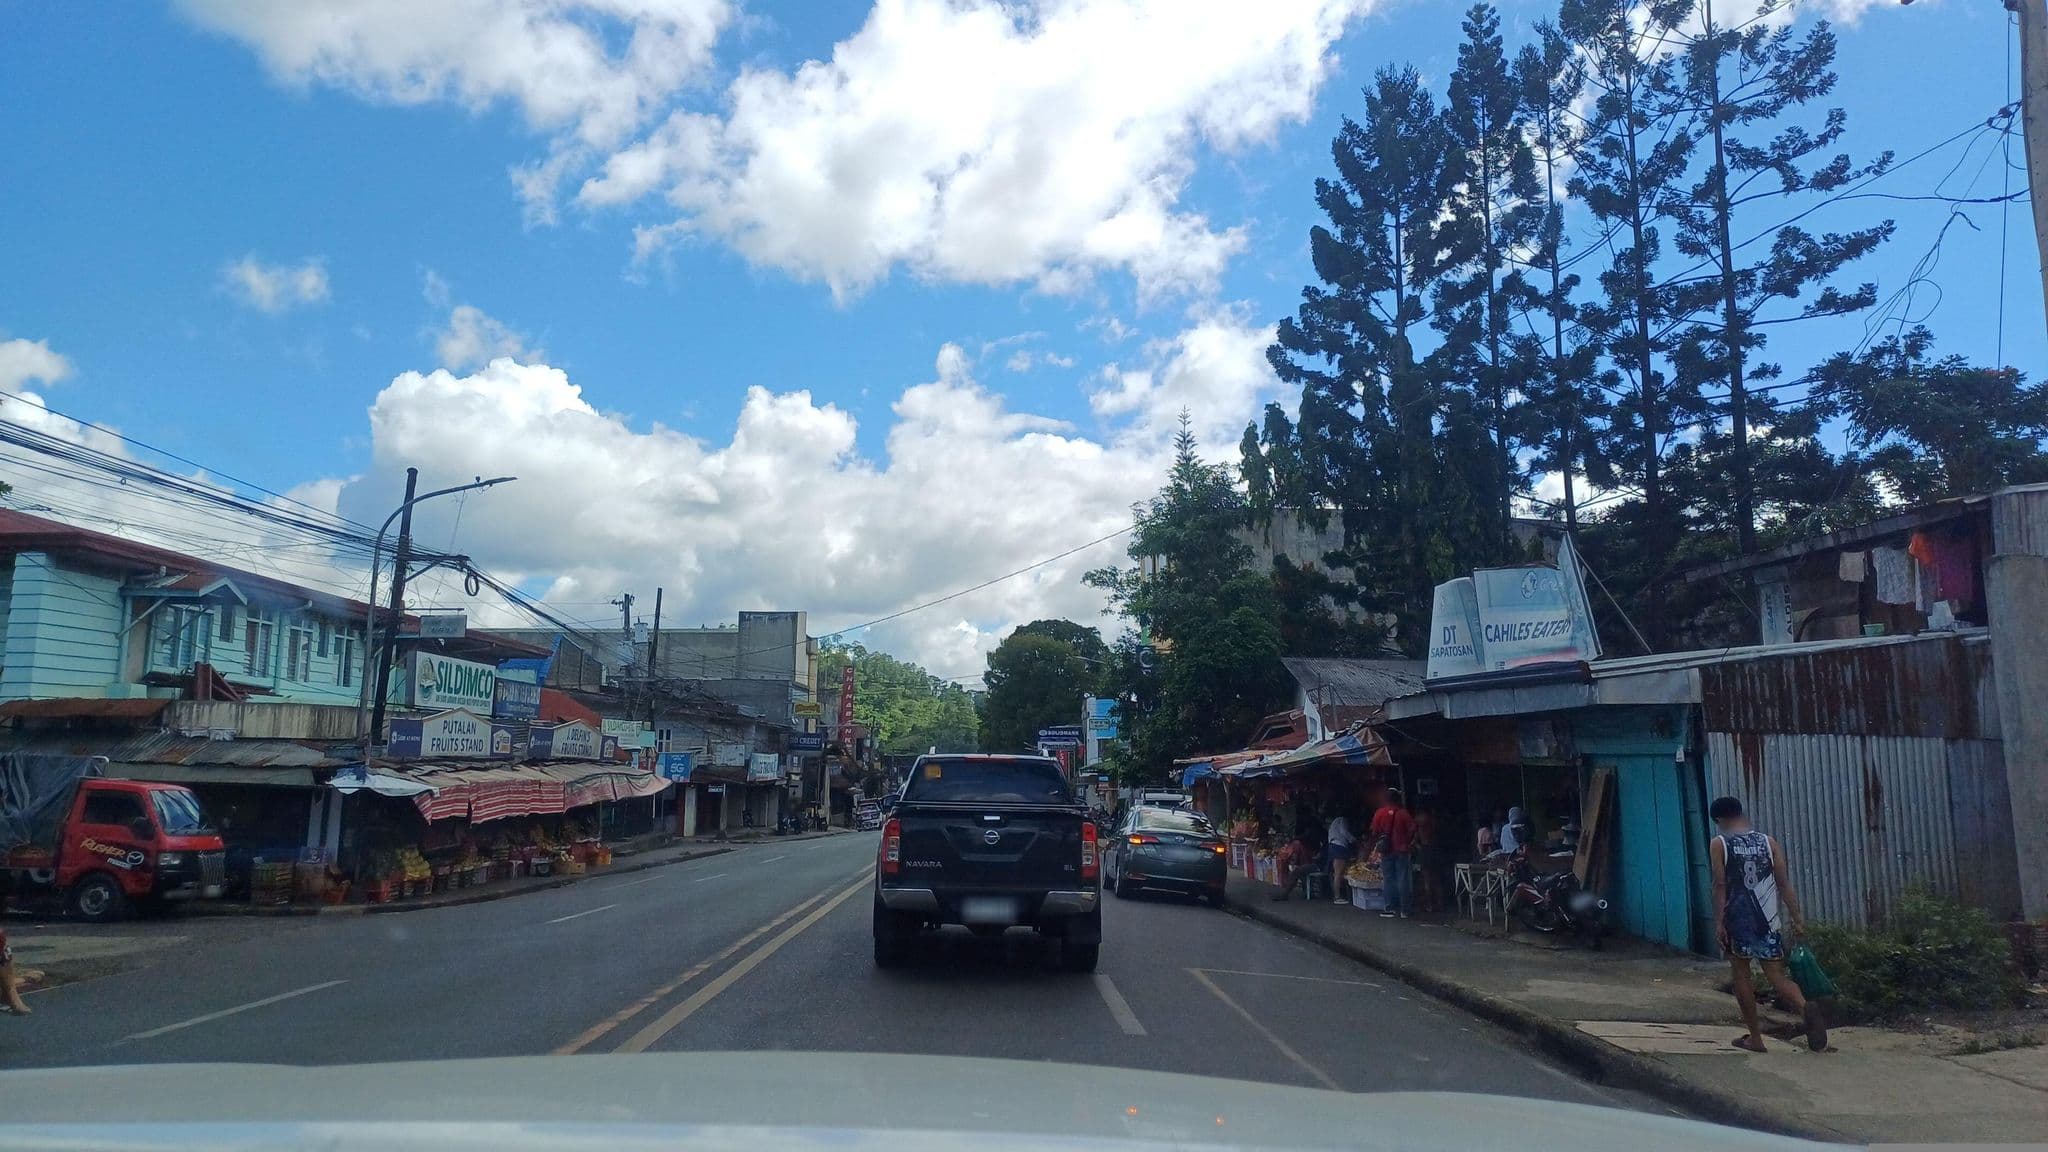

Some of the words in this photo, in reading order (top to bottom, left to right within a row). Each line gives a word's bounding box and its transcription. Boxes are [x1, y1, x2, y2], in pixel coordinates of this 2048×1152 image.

[1443, 625, 1457, 646] DT
[1485, 622, 1530, 643] CAHILES
[1430, 645, 1474, 658] SAPATOSAN
[436, 660, 494, 700] SILDIMCO
[442, 719, 477, 735] PUTALAN
[431, 738, 459, 753] FRUITS
[460, 738, 485, 754] STAND
[799, 737, 822, 745] CREDIT
[670, 763, 685, 773] 5G
[905, 860, 943, 869] NAVARA
[1743, 861, 1758, 890] 8
